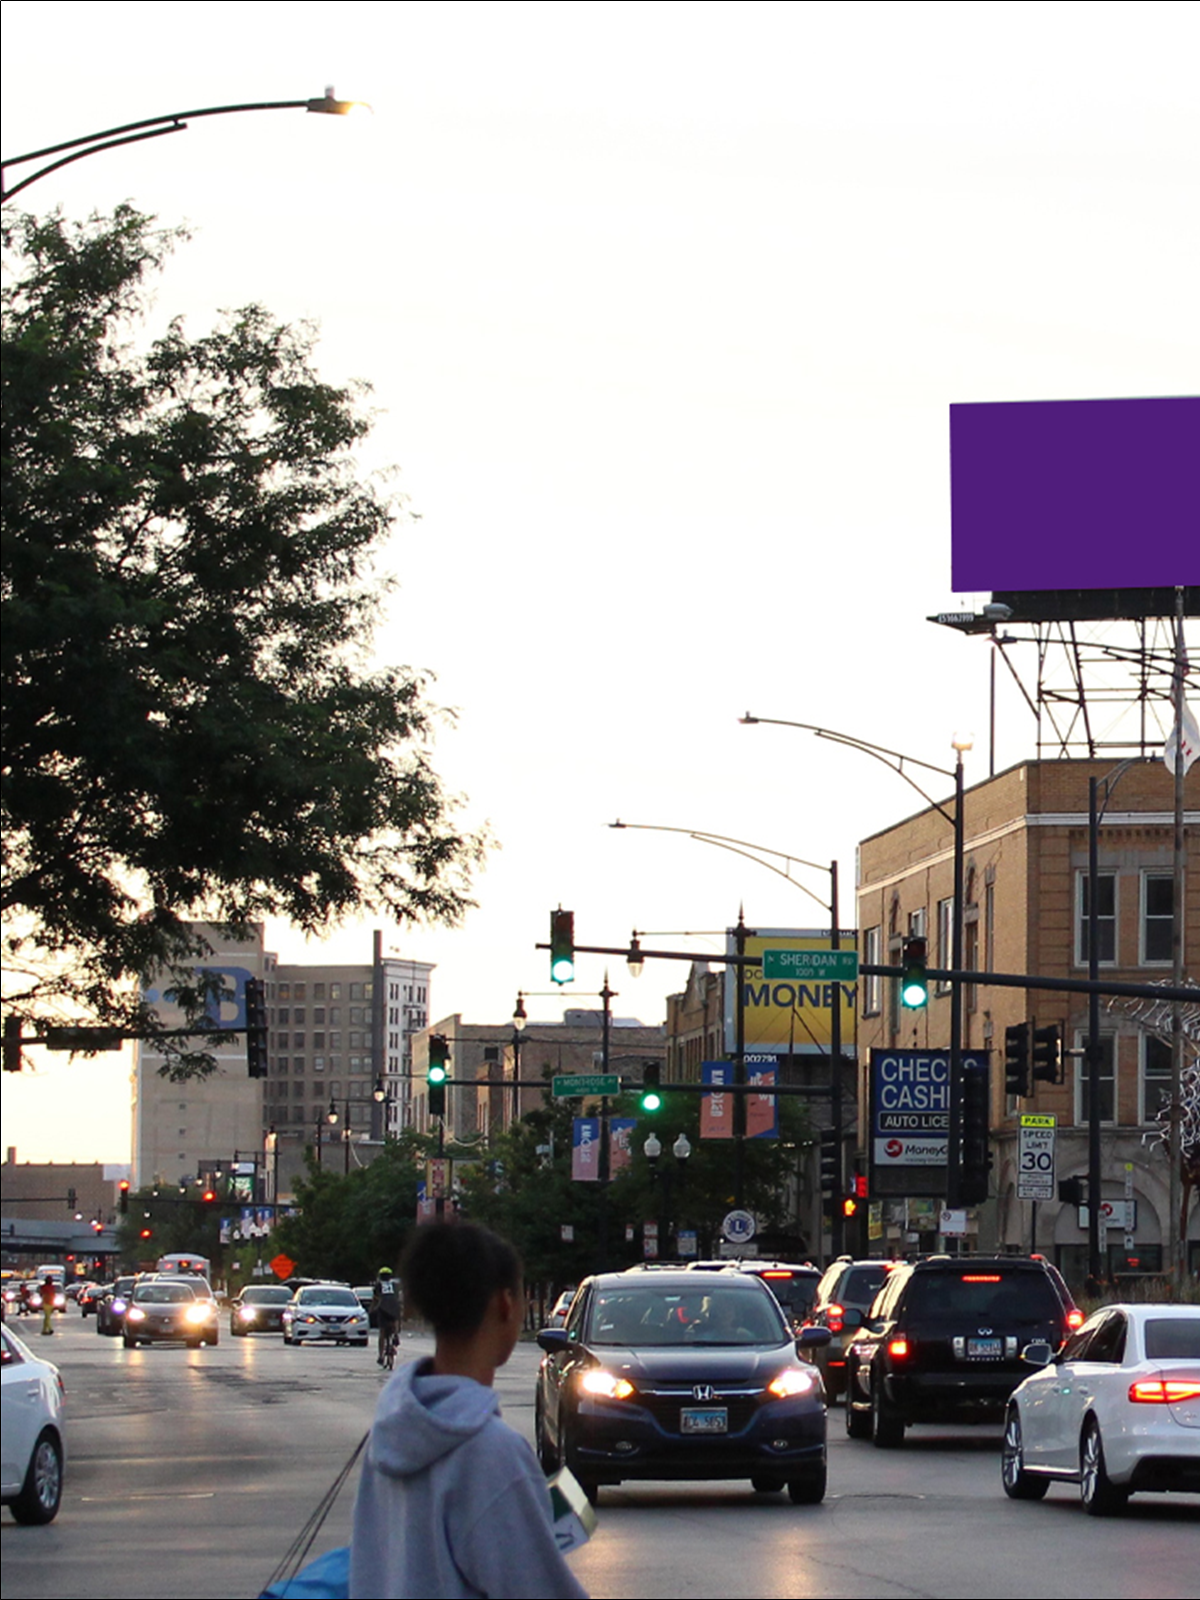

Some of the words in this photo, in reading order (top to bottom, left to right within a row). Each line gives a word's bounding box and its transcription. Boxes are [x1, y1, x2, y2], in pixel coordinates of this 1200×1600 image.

[780, 954, 837, 966] SHERIDAN
[744, 983, 856, 1008] MONEY
[563, 1077, 605, 1087] MONTROSE
[881, 1085, 950, 1108] CASH
[885, 1116, 919, 1127] AUTO
[922, 1116, 949, 1127] LICE
[1025, 1117, 1050, 1125] PARK
[1023, 1130, 1053, 1139] SPEED
[1026, 1142, 1048, 1150] LIMIT
[1022, 1152, 1052, 1171] 30
